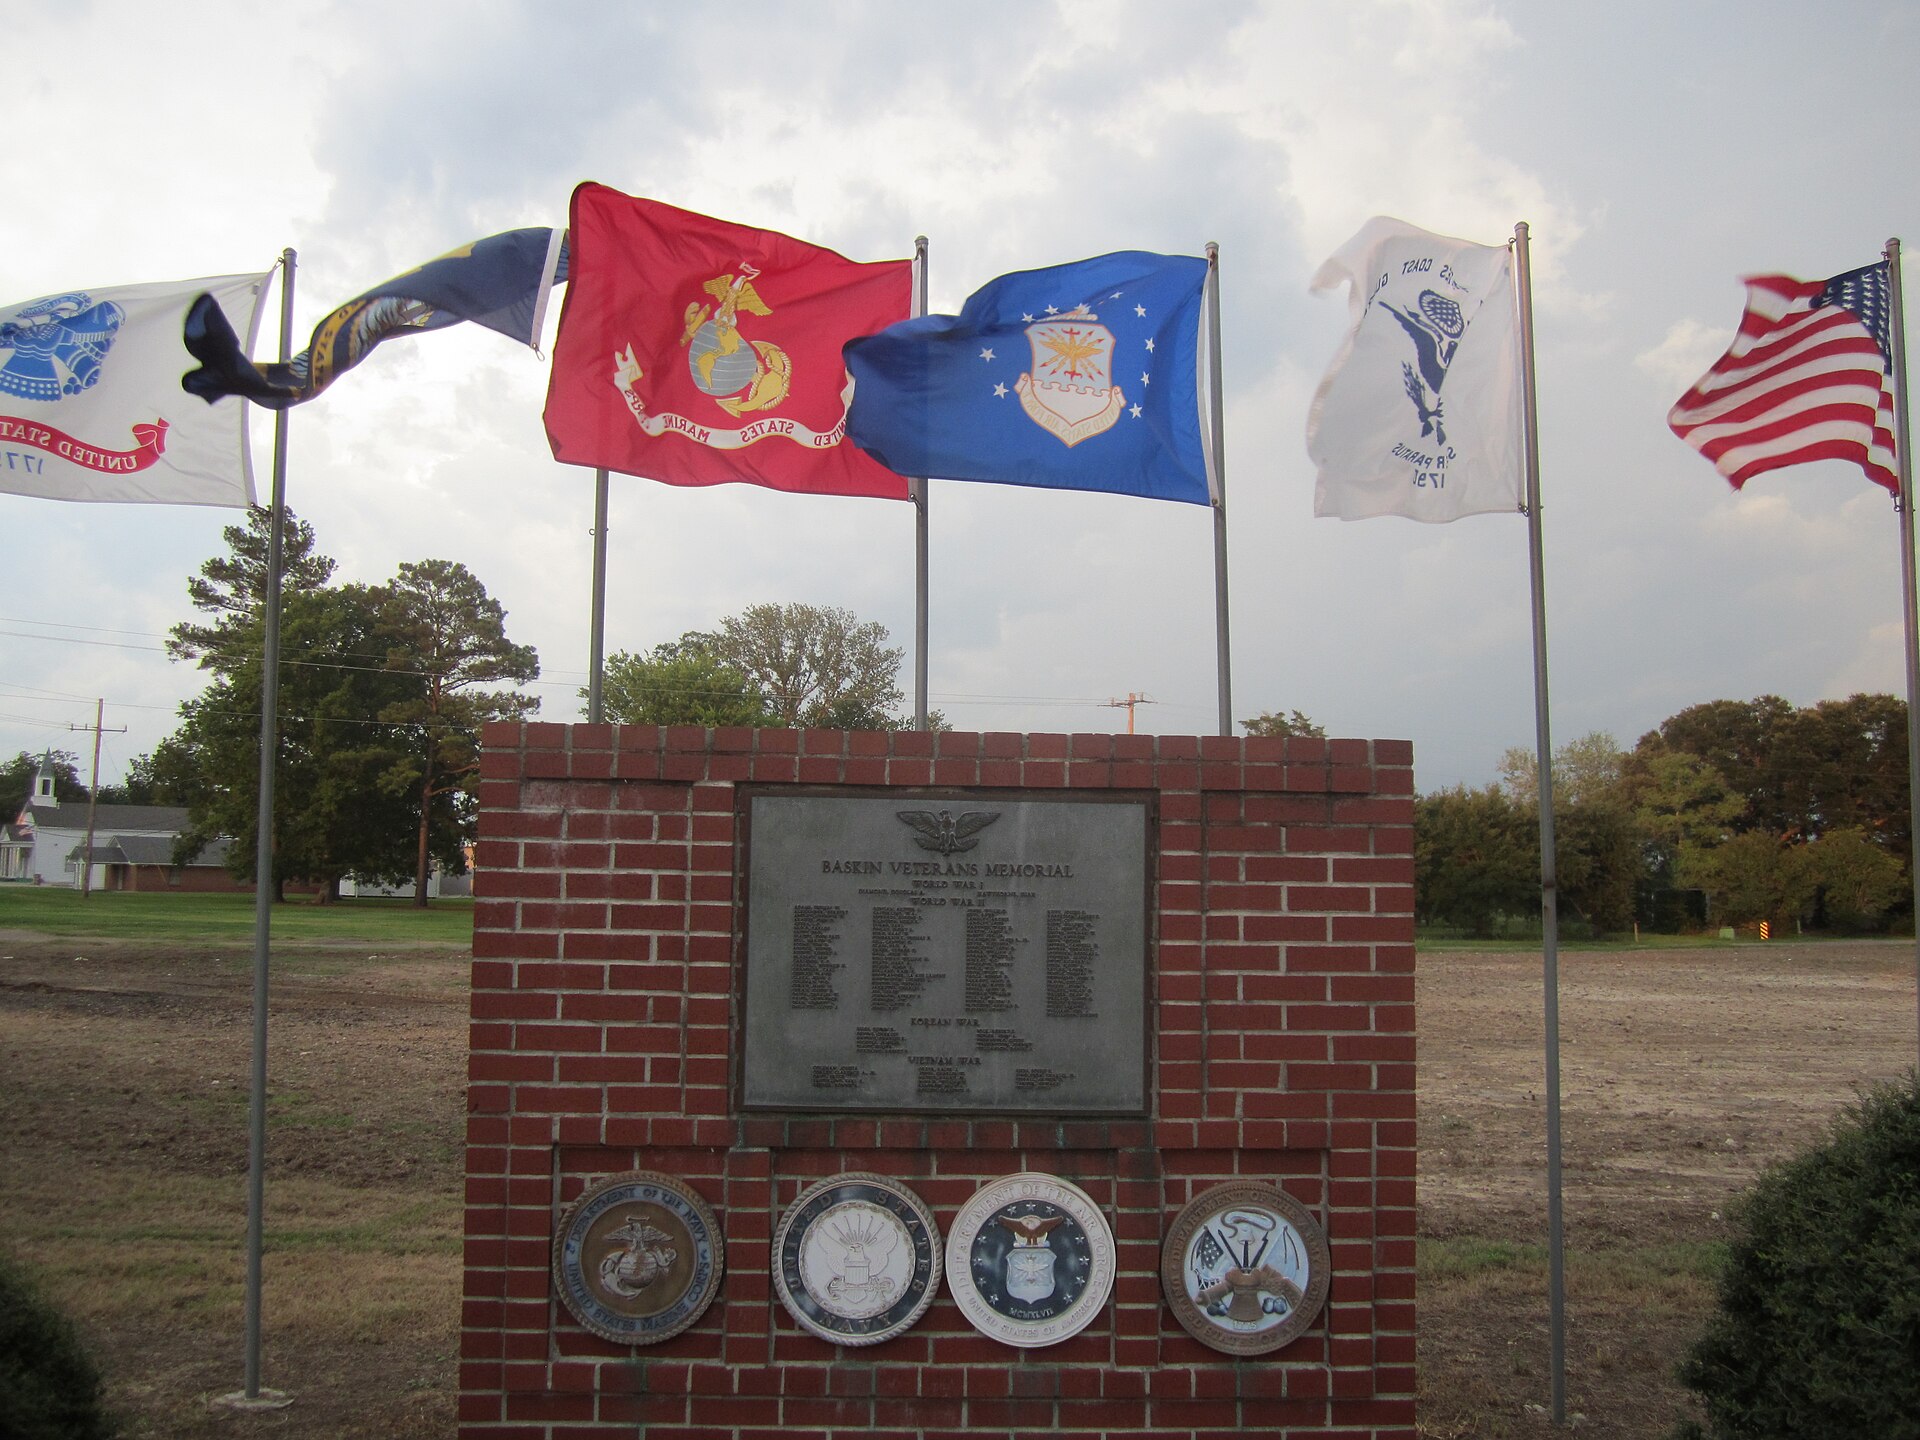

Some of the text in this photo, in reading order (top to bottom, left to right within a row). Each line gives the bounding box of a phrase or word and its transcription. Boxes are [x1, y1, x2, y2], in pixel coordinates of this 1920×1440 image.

[821, 860, 1074, 878] BASKIN VETERANS MEMORIAL
[912, 879, 949, 890] WORLD
[952, 879, 976, 890] WAR
[910, 897, 986, 907] WORLD WAR II
[911, 1017, 980, 1028] KOREAN WAR
[908, 1056, 982, 1066] VIETNAM WAR
[643, 1188, 658, 1199] OF
[683, 1208, 709, 1243] NAVY
[1173, 1191, 1248, 1260] DEPARTMENT
[1250, 1191, 1270, 1204] OF
[1273, 1197, 1299, 1221] THE
[784, 1191, 931, 1294] UNITED STATES
[954, 1184, 1111, 1289] DEPARTMENT OF THE AIR FORCE
[567, 1263, 593, 1310] UNITED
[594, 1308, 636, 1332] STATES
[687, 1261, 711, 1303] CORPS
[818, 1311, 892, 1334] NAVY
[968, 1297, 999, 1329] UNITED
[1043, 1326, 1058, 1337] OF
